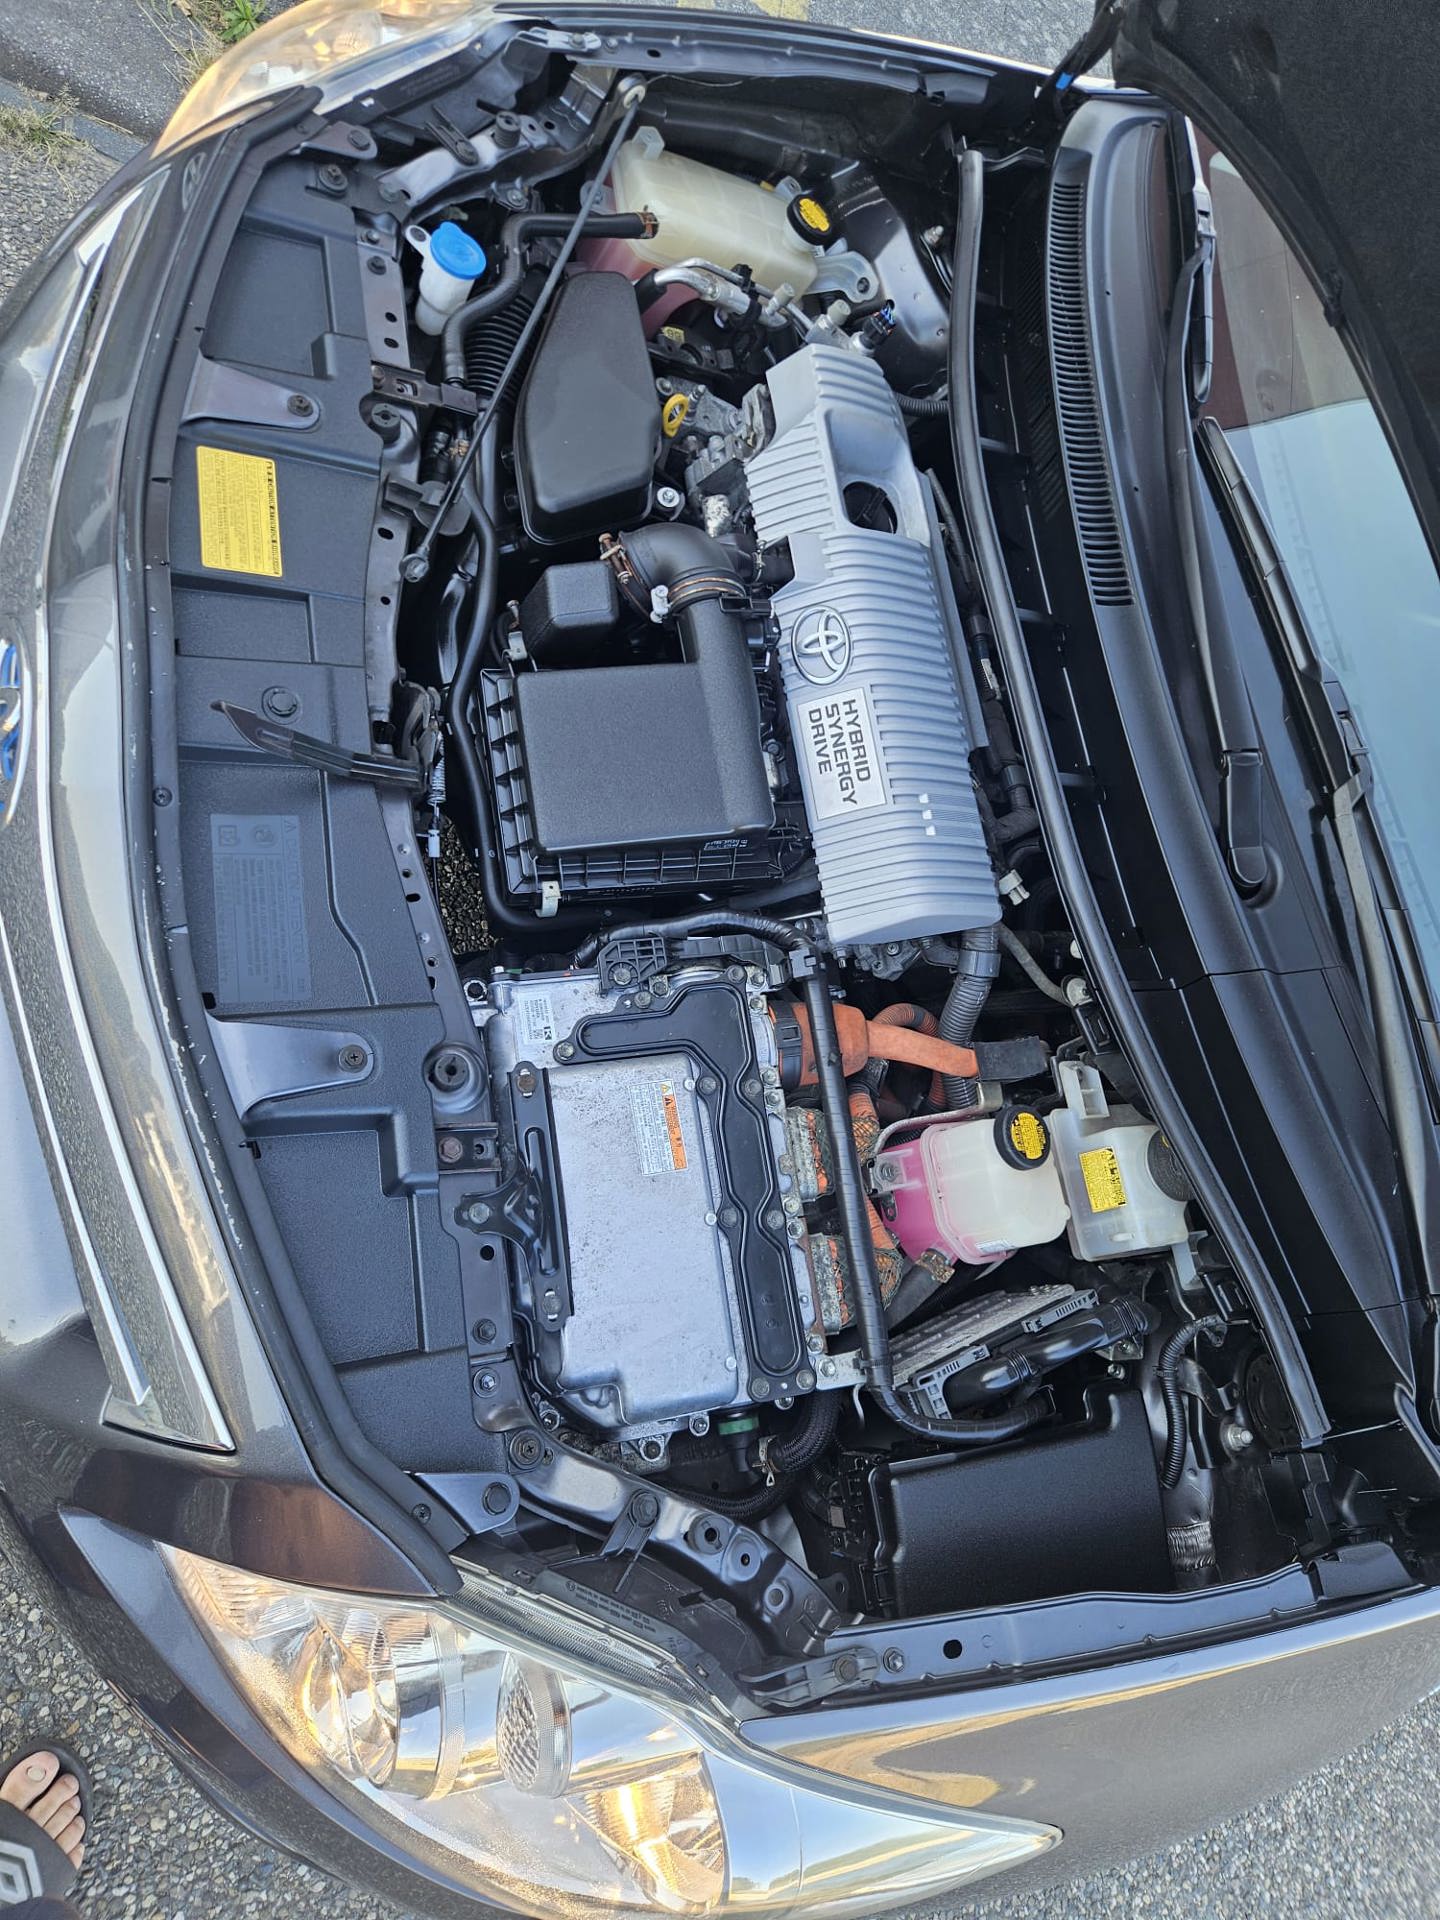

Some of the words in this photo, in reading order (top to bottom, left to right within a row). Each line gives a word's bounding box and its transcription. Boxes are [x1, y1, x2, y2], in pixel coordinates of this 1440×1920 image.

[808, 708, 832, 774] DRIVE
[825, 703, 857, 805] SYNERGY
[842, 699, 871, 781] HYBRID
[286, 839, 299, 890] CAUTION
[288, 895, 305, 963] ATTENTION
